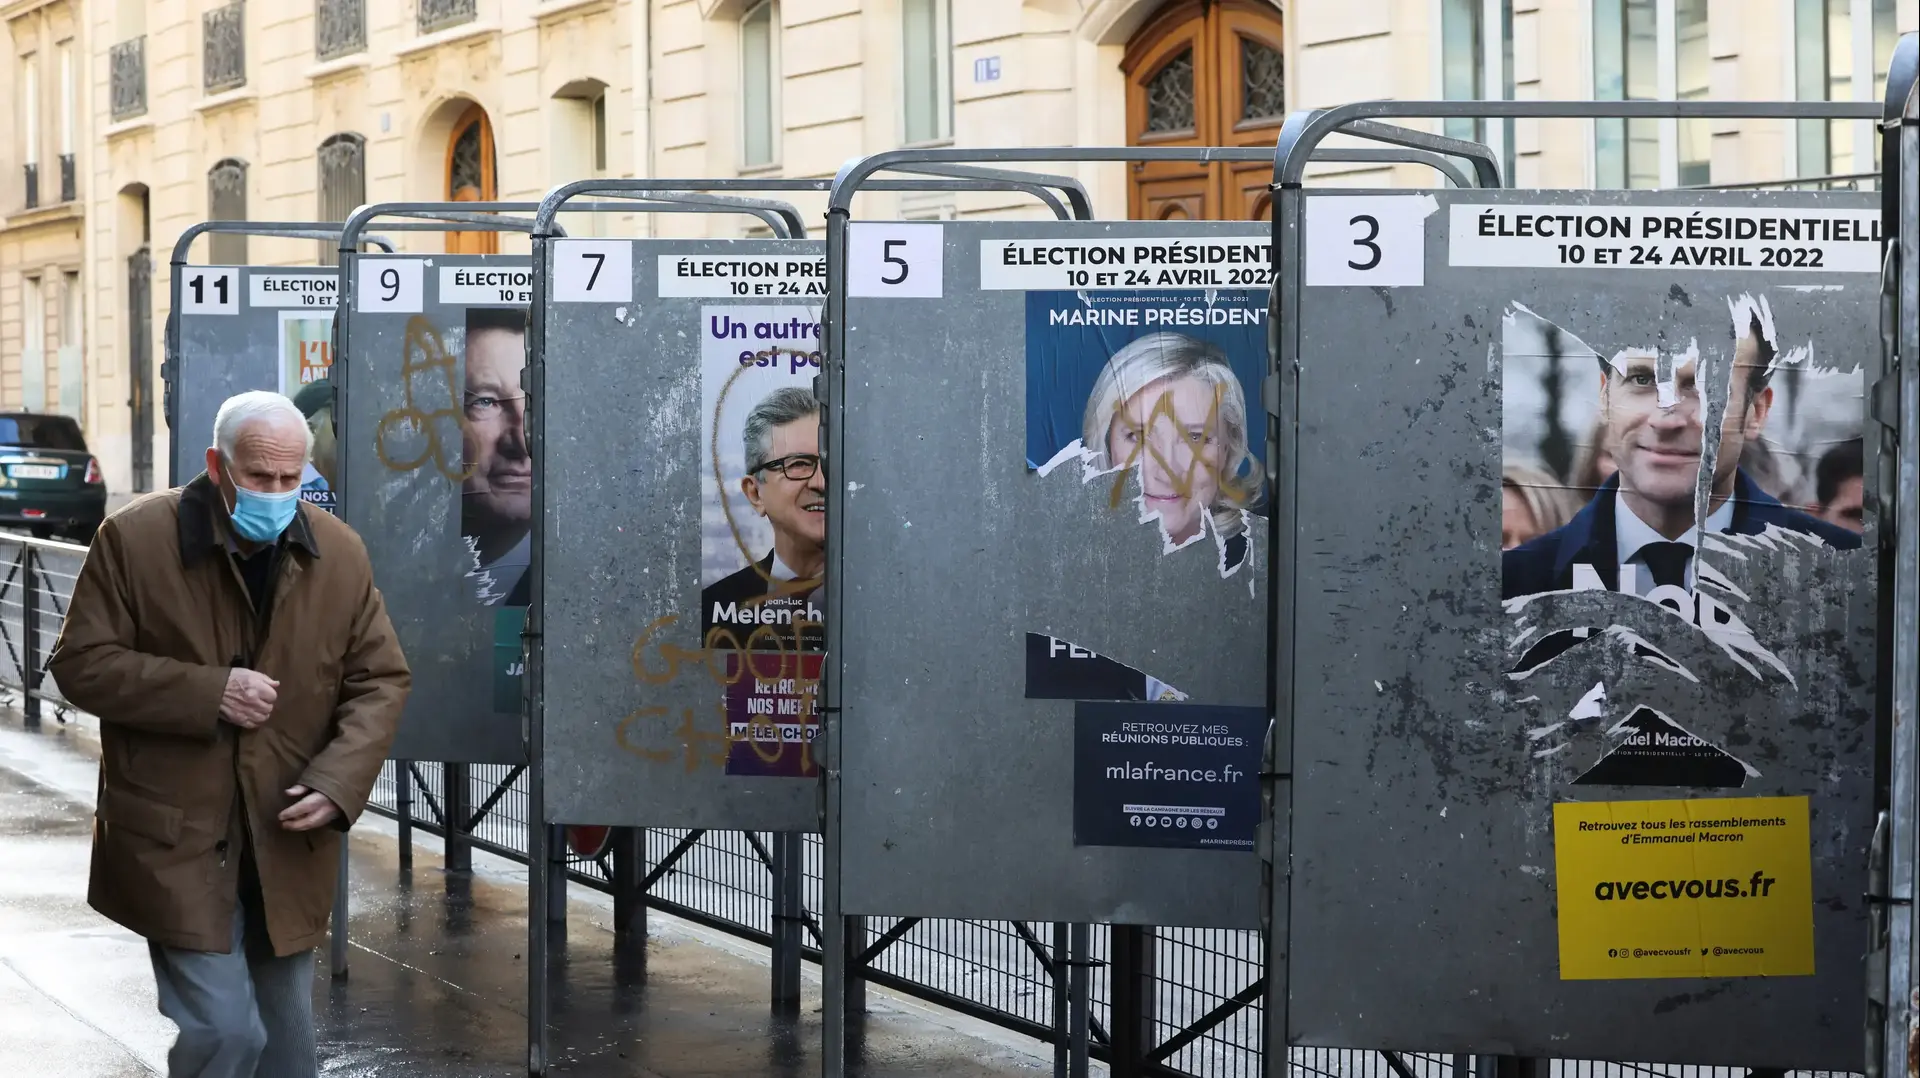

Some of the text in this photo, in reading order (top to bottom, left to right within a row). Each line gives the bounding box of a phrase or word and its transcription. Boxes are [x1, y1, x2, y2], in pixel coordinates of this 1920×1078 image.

[1478, 208, 1882, 242] ÉLECTION PRÉSIDENTIELL
[1347, 214, 1383, 271] 3
[881, 240, 909, 285] 5
[1003, 241, 1272, 265] ÉLECTION PRÉSIDENT
[1558, 245, 1824, 267] 10 ET 24 AVRIL 2022
[582, 254, 605, 291] 7
[677, 258, 826, 277] ÉLECTION PRÉ
[263, 277, 336, 291] ÉLECTION
[379, 268, 401, 302] 9
[1067, 270, 1089, 286] 10
[1096, 272, 1118, 286] ET
[1125, 270, 1151, 286] 24
[1157, 269, 1222, 285] AVRIL
[189, 275, 228, 304] 11
[499, 290, 514, 301] 10
[730, 282, 748, 295] 10
[755, 284, 773, 295] ET
[778, 282, 800, 295] 24
[302, 295, 315, 305] 10
[319, 297, 332, 305] ET
[1049, 307, 1139, 326] MARINE
[711, 316, 747, 339] Un
[739, 346, 778, 368] est
[303, 491, 329, 502] NOS
[747, 697, 774, 714] NOS
[1122, 722, 1229, 735] RETROUVEZ MES
[1102, 731, 1168, 744] RÉUNIONS
[1172, 736, 1243, 747] PUBLIQUES
[1106, 761, 1244, 783] mlafrance.fr
[1578, 816, 1786, 832] Retrouvez tous les rassemblements
[1621, 832, 1744, 844] d'Emmanuel Macron
[1595, 870, 1776, 901] avecvous.fr
[1633, 946, 1765, 958] @avecvousfr @avecvous
